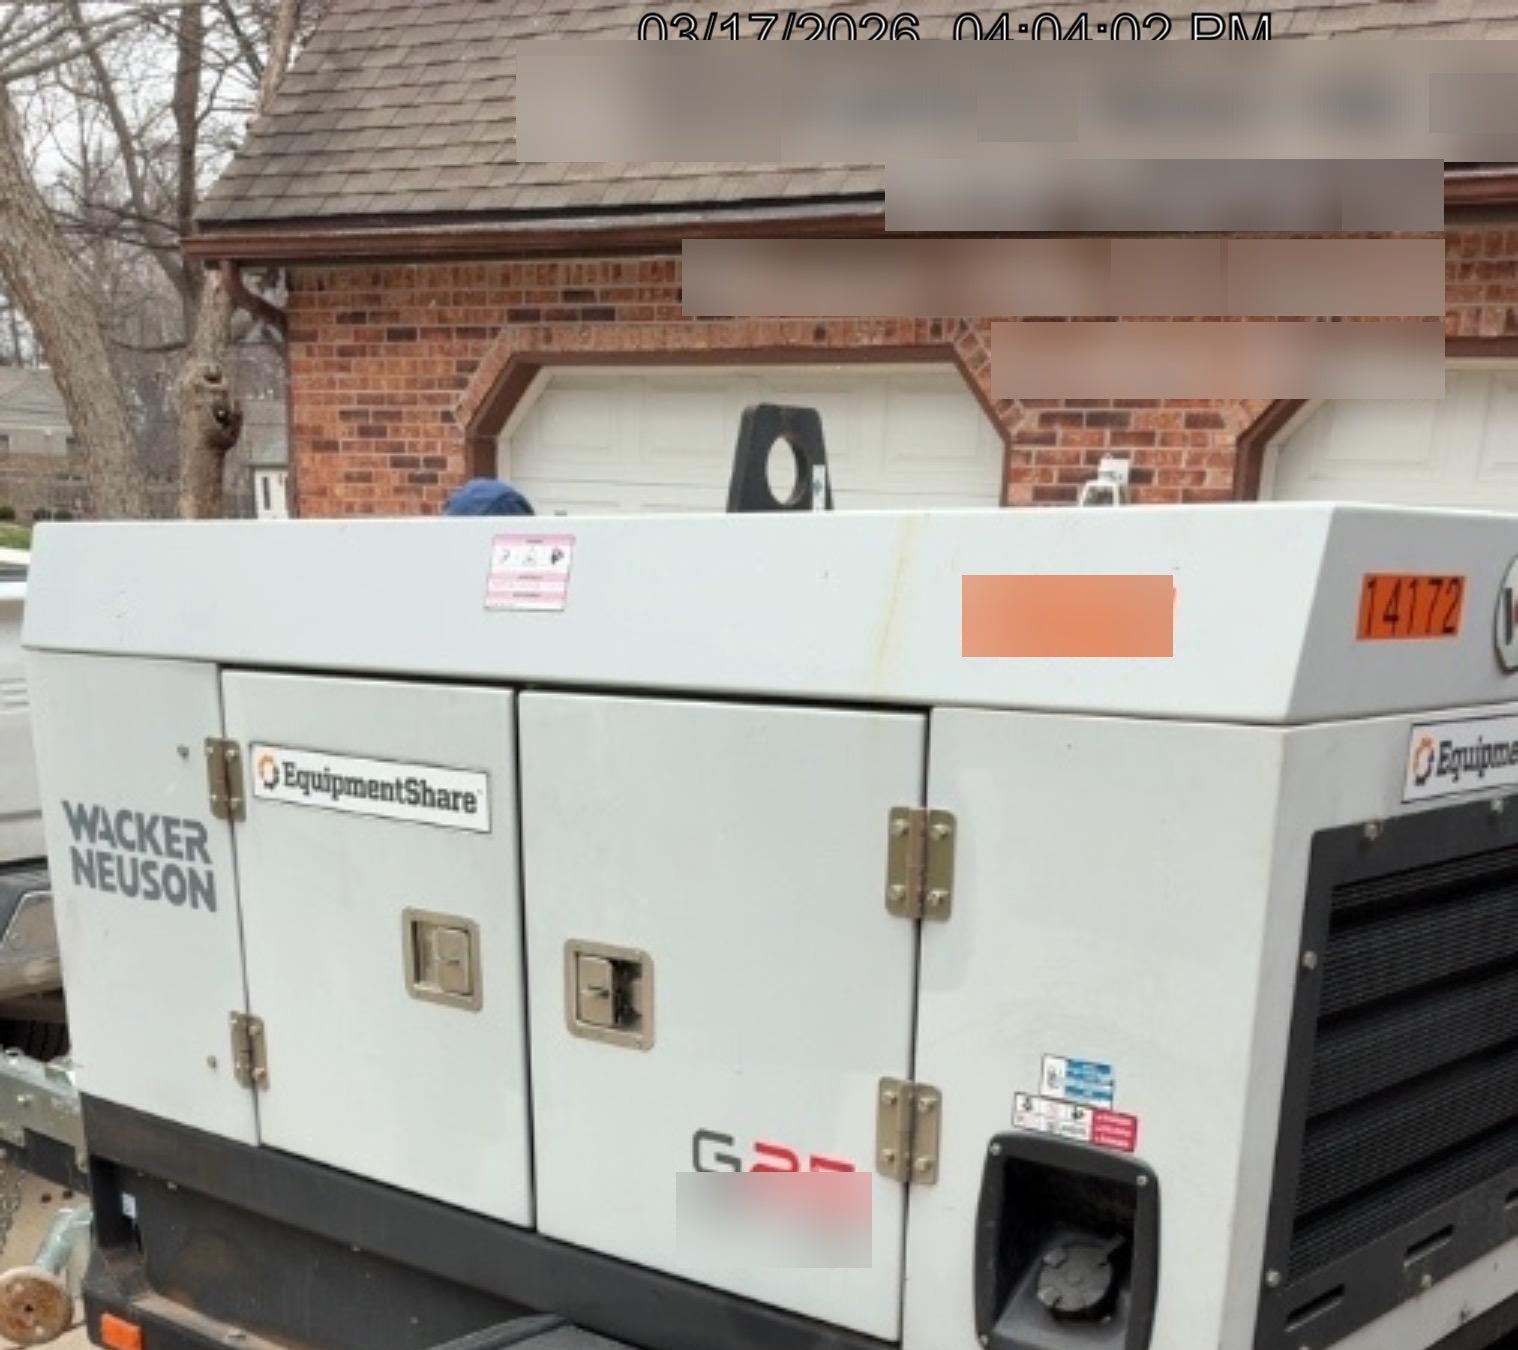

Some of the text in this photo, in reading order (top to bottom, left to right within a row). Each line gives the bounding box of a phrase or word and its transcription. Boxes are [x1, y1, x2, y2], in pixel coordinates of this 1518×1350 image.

[1362, 575, 1463, 636] 14172
[282, 760, 478, 815] EquipmentShare
[61, 799, 213, 865] WACKER
[70, 845, 217, 913] NEUSON
